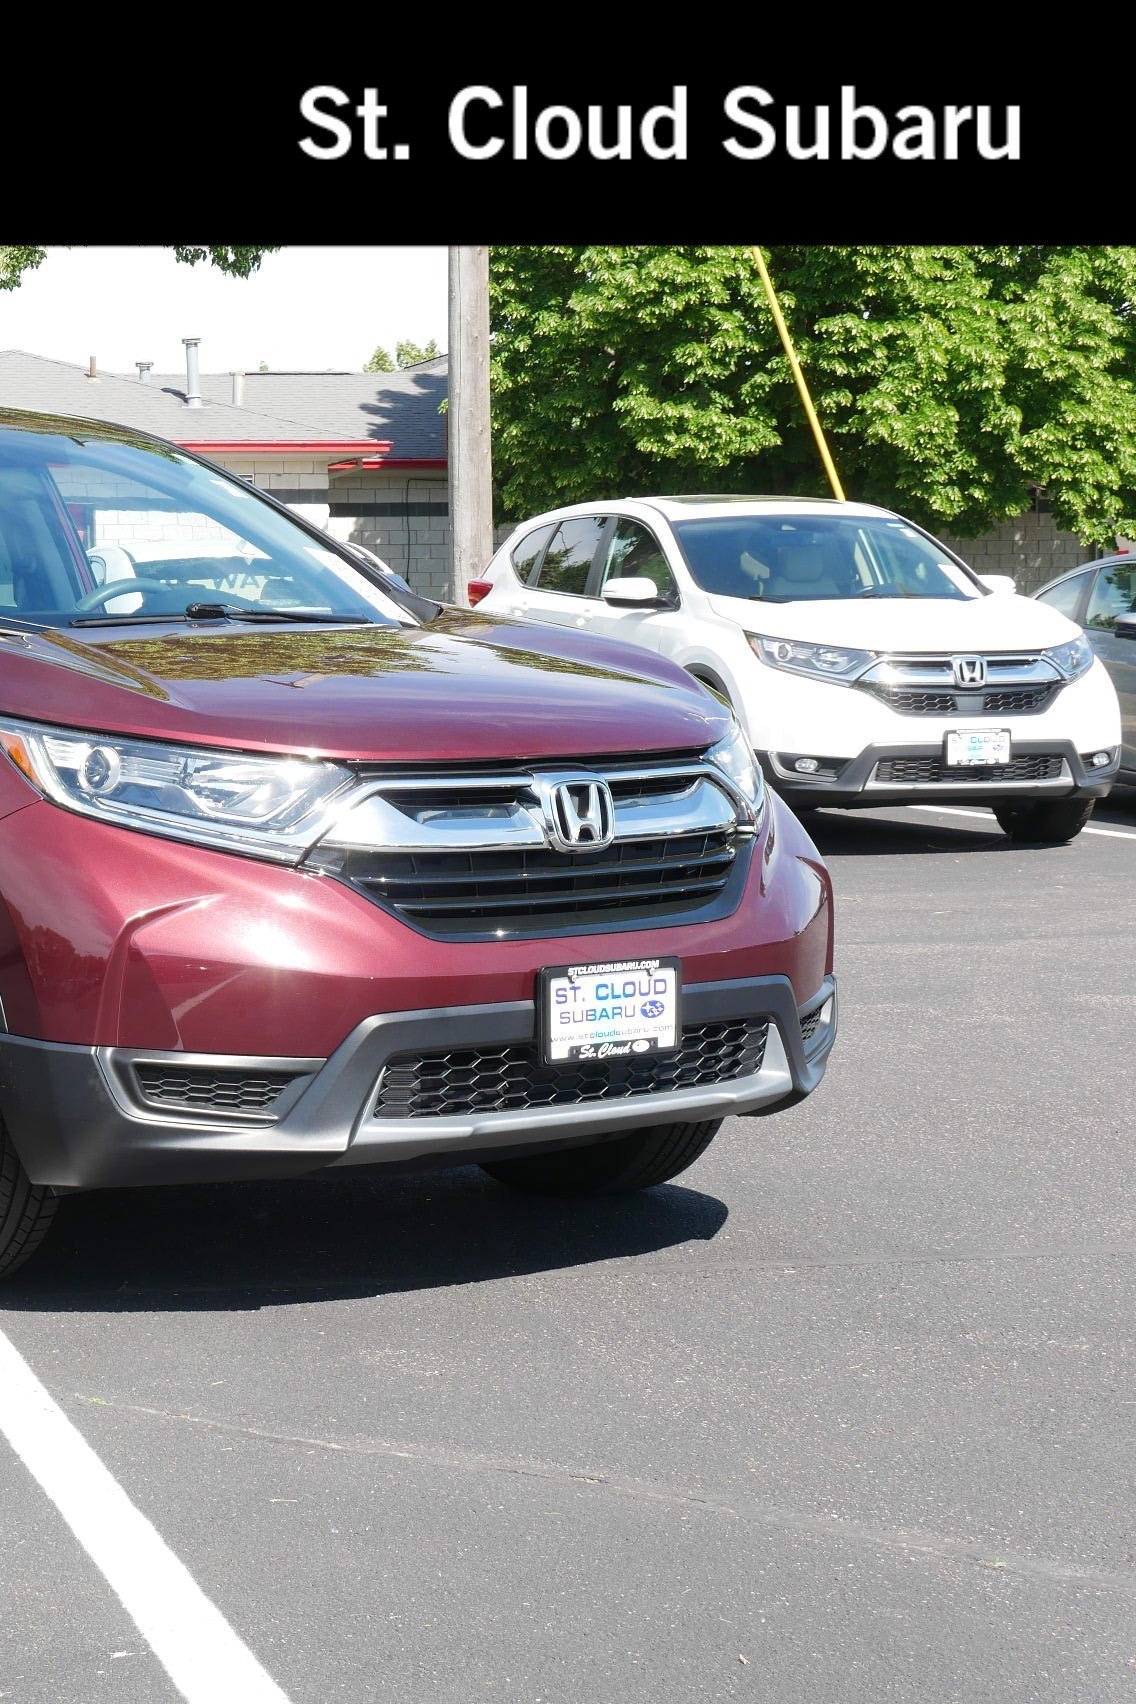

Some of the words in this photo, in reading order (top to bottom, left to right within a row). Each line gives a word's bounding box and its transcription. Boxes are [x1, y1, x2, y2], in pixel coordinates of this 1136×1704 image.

[567, 959, 660, 976] STCLOUDSUBARU.COM
[555, 985, 585, 1005] ST.
[595, 978, 667, 1001] CLOUD
[559, 1004, 636, 1025] SUBARU
[578, 1043, 597, 1059] St.
[597, 1041, 632, 1059] Cloud
